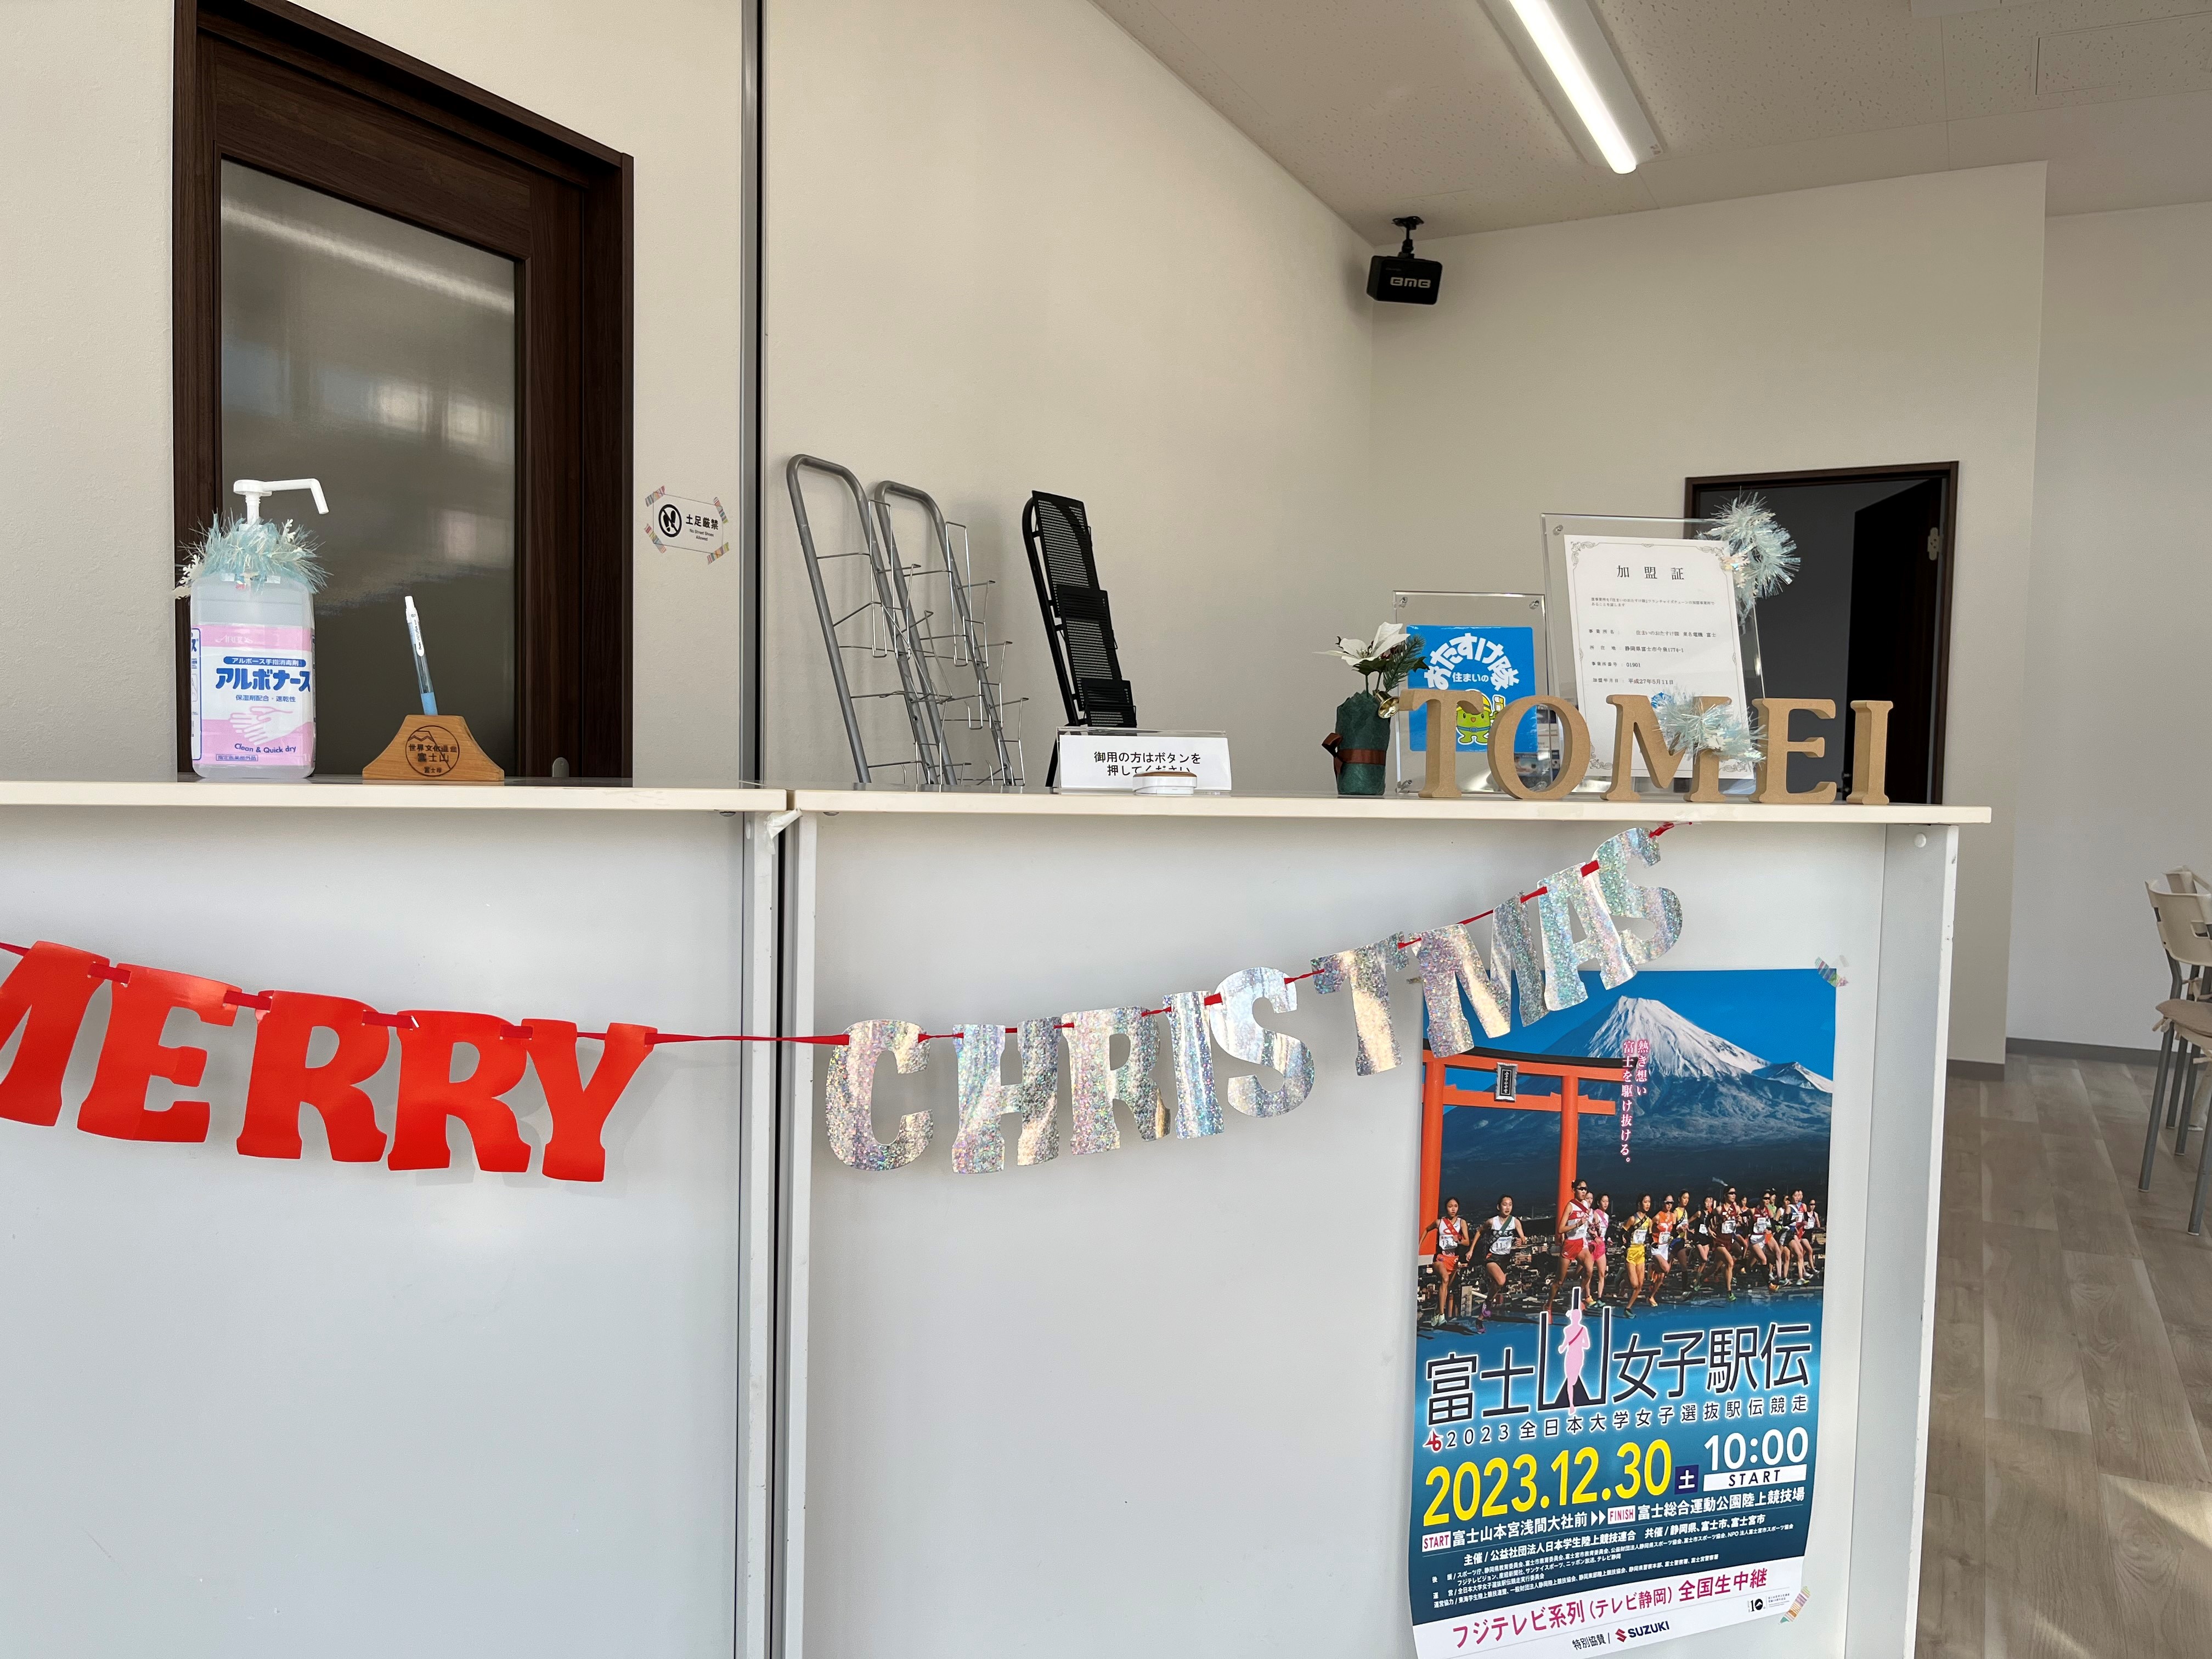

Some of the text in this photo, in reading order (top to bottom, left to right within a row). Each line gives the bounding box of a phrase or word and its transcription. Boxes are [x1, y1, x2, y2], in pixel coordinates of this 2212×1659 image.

[1390, 276, 1431, 289] BMB
[685, 514, 719, 531] 土足厳禁
[1616, 565, 1685, 581] 加盟証
[216, 668, 311, 692] アルボナース
[1452, 672, 1489, 682] 住まいの
[234, 743, 253, 752] Clean
[1093, 751, 1201, 764] 御用の方はボタンを
[1398, 689, 1893, 804] TOMEI
[825, 827, 1683, 1175] CHRISTMAS
[1636, 1040, 1649, 1096] 熱き想い
[1620, 1041, 1635, 1163] 富士を駆け抜ける。
[1704, 1426, 1809, 1471] 10:00
[1423, 1439, 1696, 1526] 2023.12.30 土
[1729, 1470, 1781, 1487] START
[1424, 1487, 1805, 1550] START 富士山本宮浅間大社前 FINISH 富士総合運動公園陸上競技場
[1679, 1568, 1768, 1602] 全国生中継
[1627, 1621, 1670, 1638] SUZUKI
